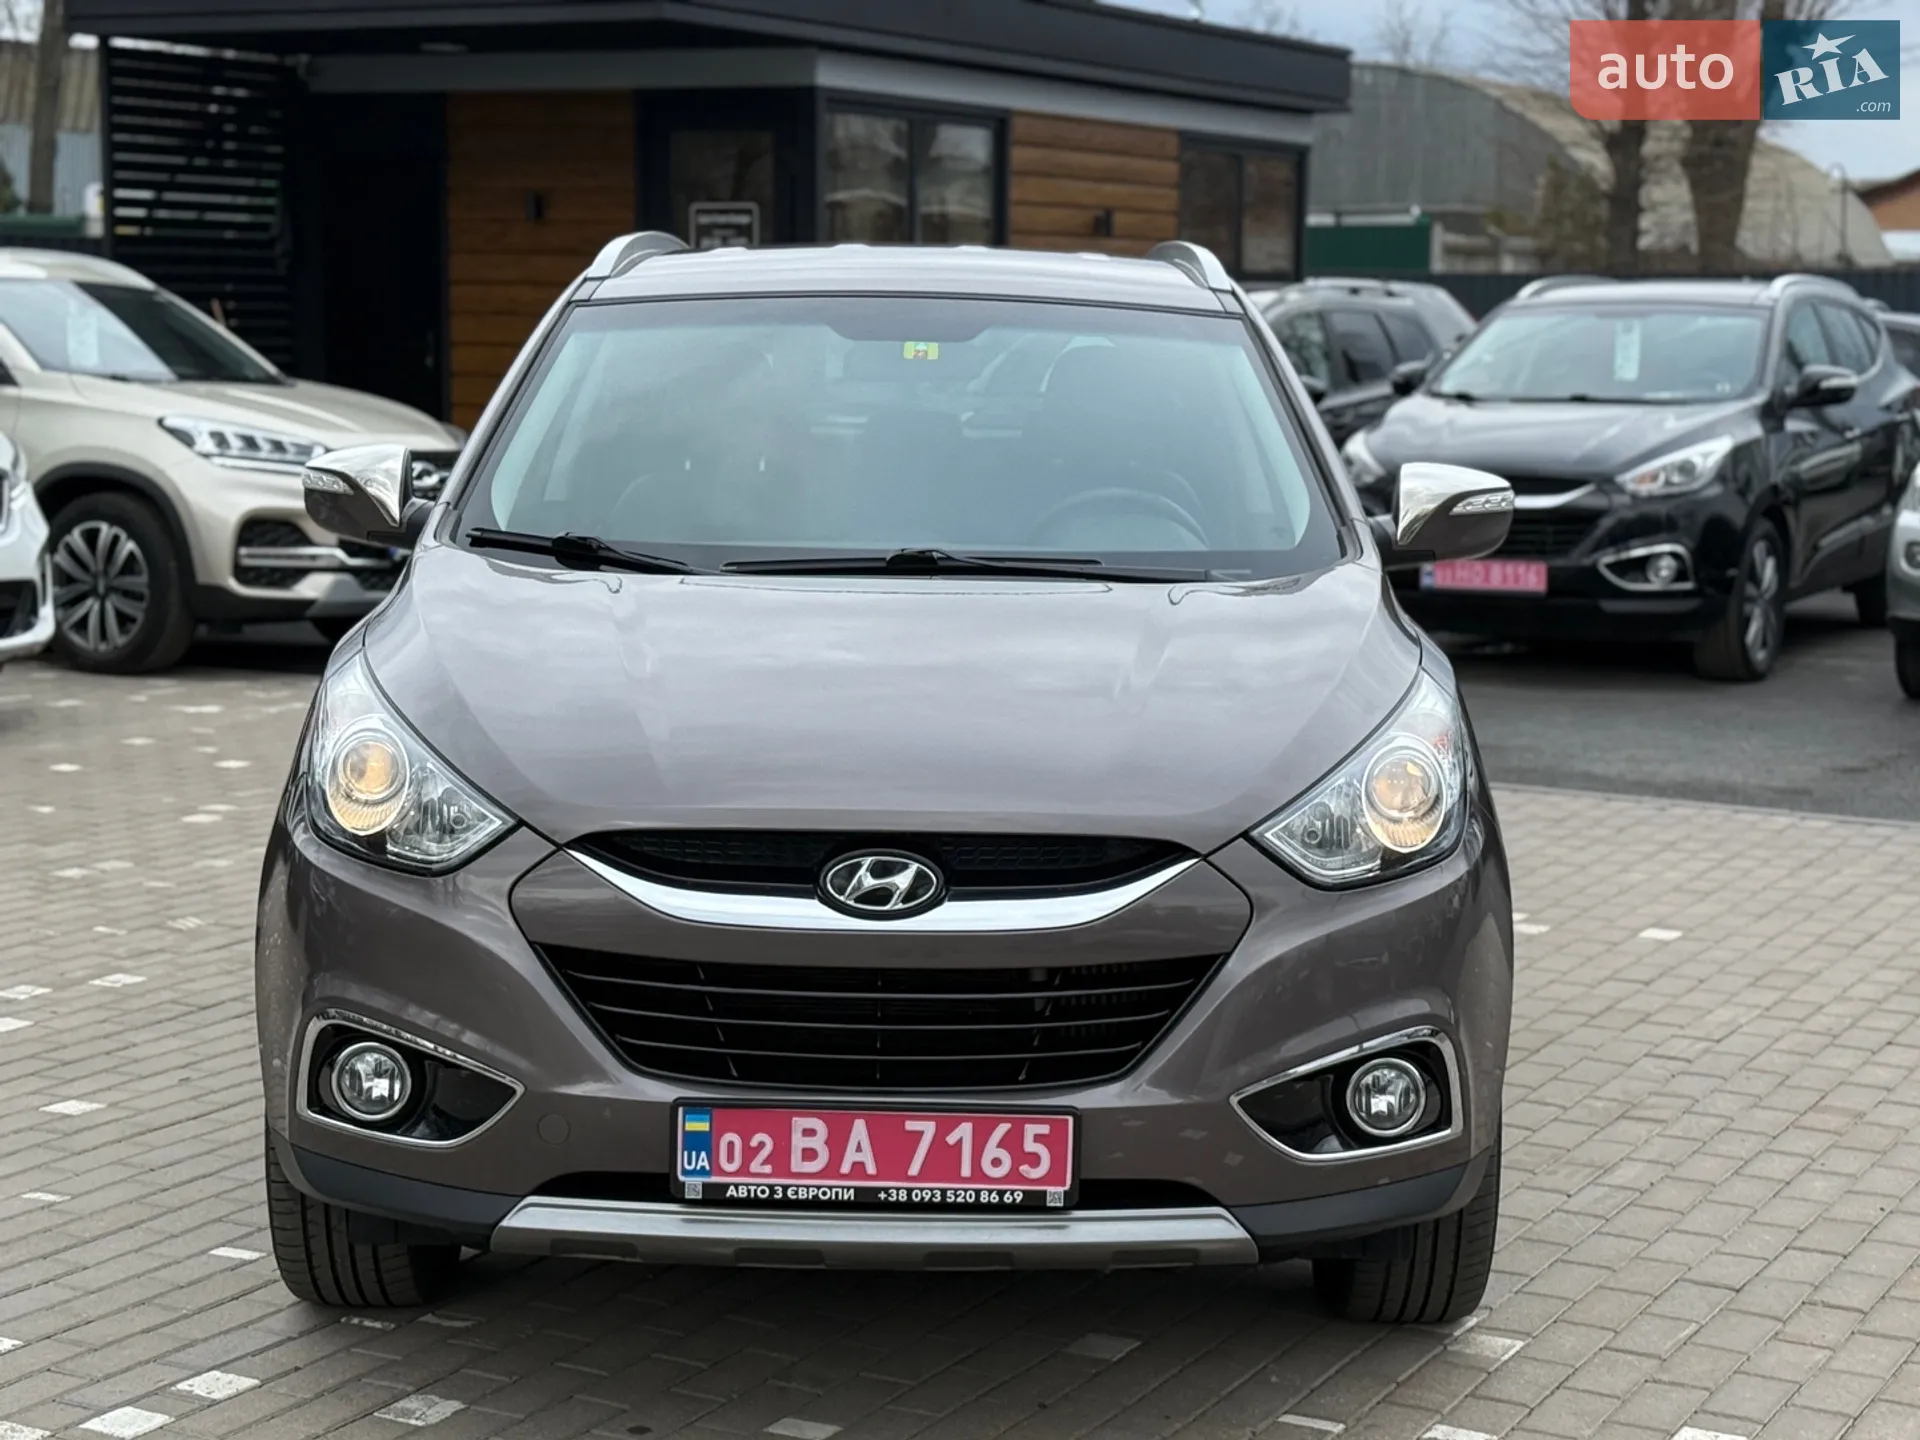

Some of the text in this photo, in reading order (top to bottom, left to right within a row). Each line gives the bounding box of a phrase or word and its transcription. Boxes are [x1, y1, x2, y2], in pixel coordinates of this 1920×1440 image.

[718, 1116, 1052, 1180] 02 BA 7165
[682, 1150, 711, 1171] UA
[726, 1184, 770, 1199] АВТО
[786, 1187, 855, 1201] ЄВРОПИ
[877, 1189, 908, 1202] +38
[911, 1189, 942, 1203] 093
[945, 1190, 976, 1204] 520
[979, 1190, 1000, 1204] 86
[1003, 1191, 1024, 1204] 69
